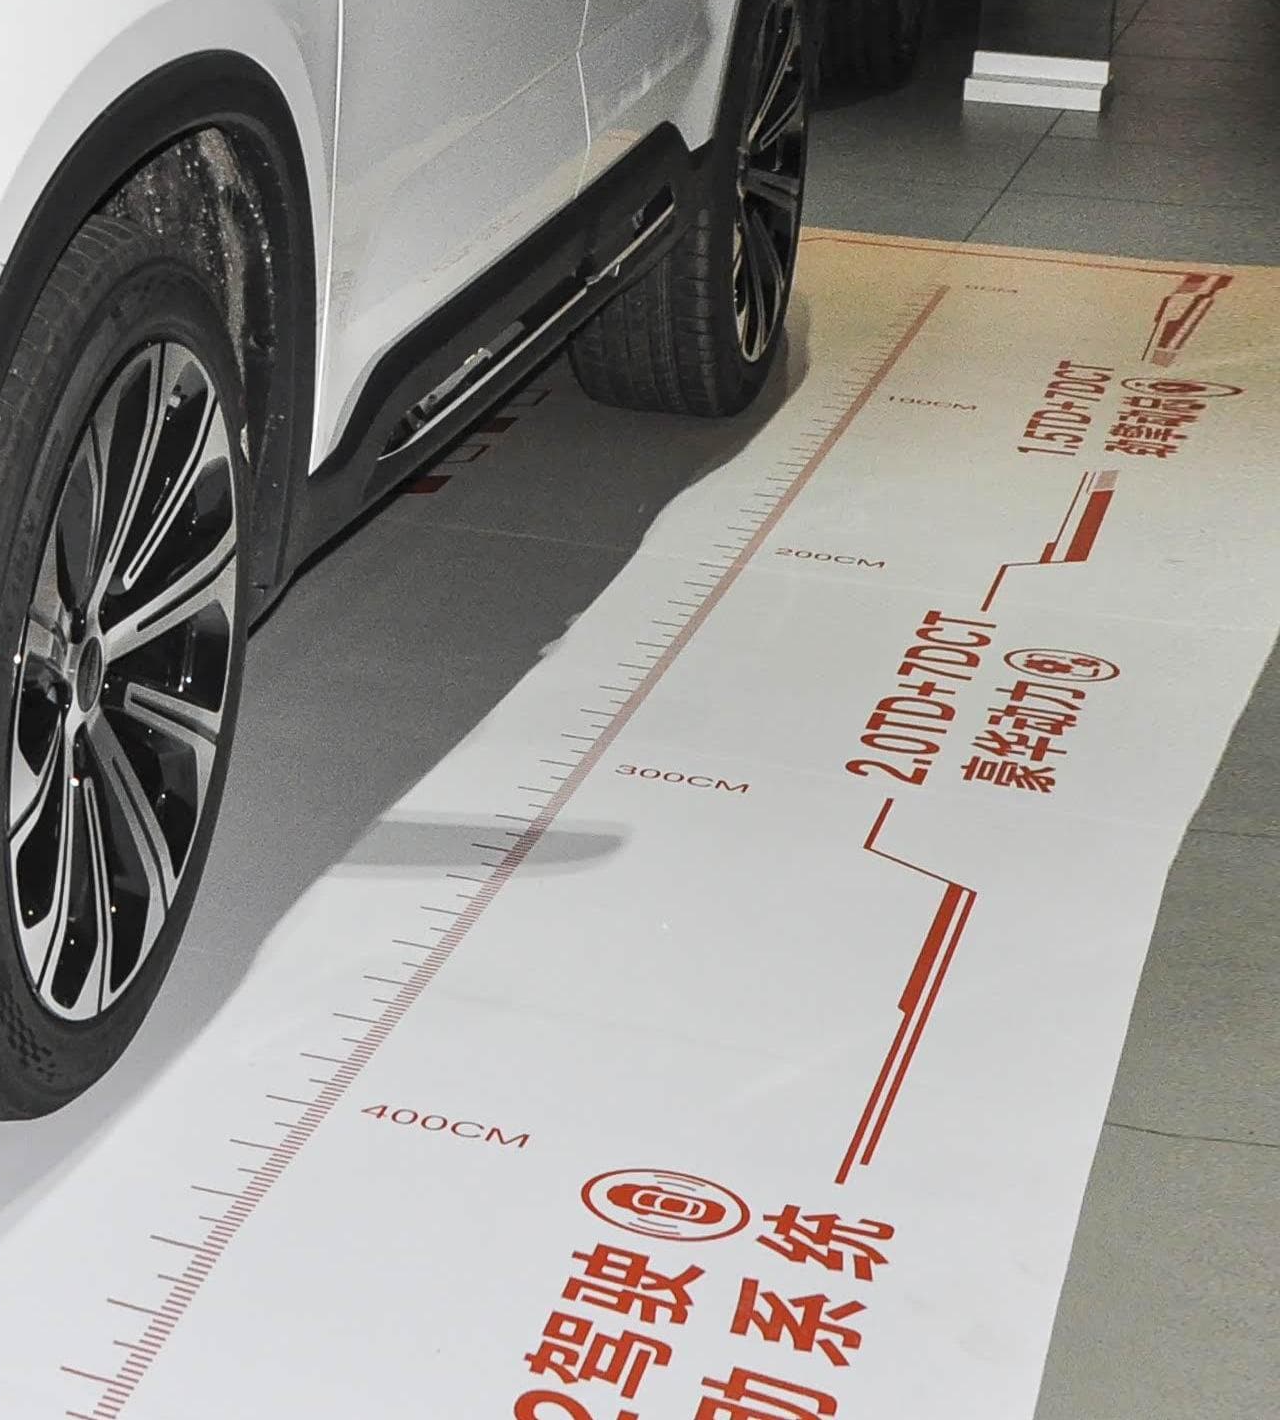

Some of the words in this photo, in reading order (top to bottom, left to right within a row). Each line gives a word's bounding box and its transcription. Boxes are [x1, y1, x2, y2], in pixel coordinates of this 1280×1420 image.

[888, 395, 978, 411] 100CM
[1017, 360, 1115, 457] 1.5TD+7DCT
[774, 546, 886, 569] 200CM
[845, 610, 998, 787] 2.0TD+7DCT
[960, 679, 1087, 794] 豪华动力
[613, 763, 751, 794] 300CM
[360, 1102, 531, 1149] 400CM
